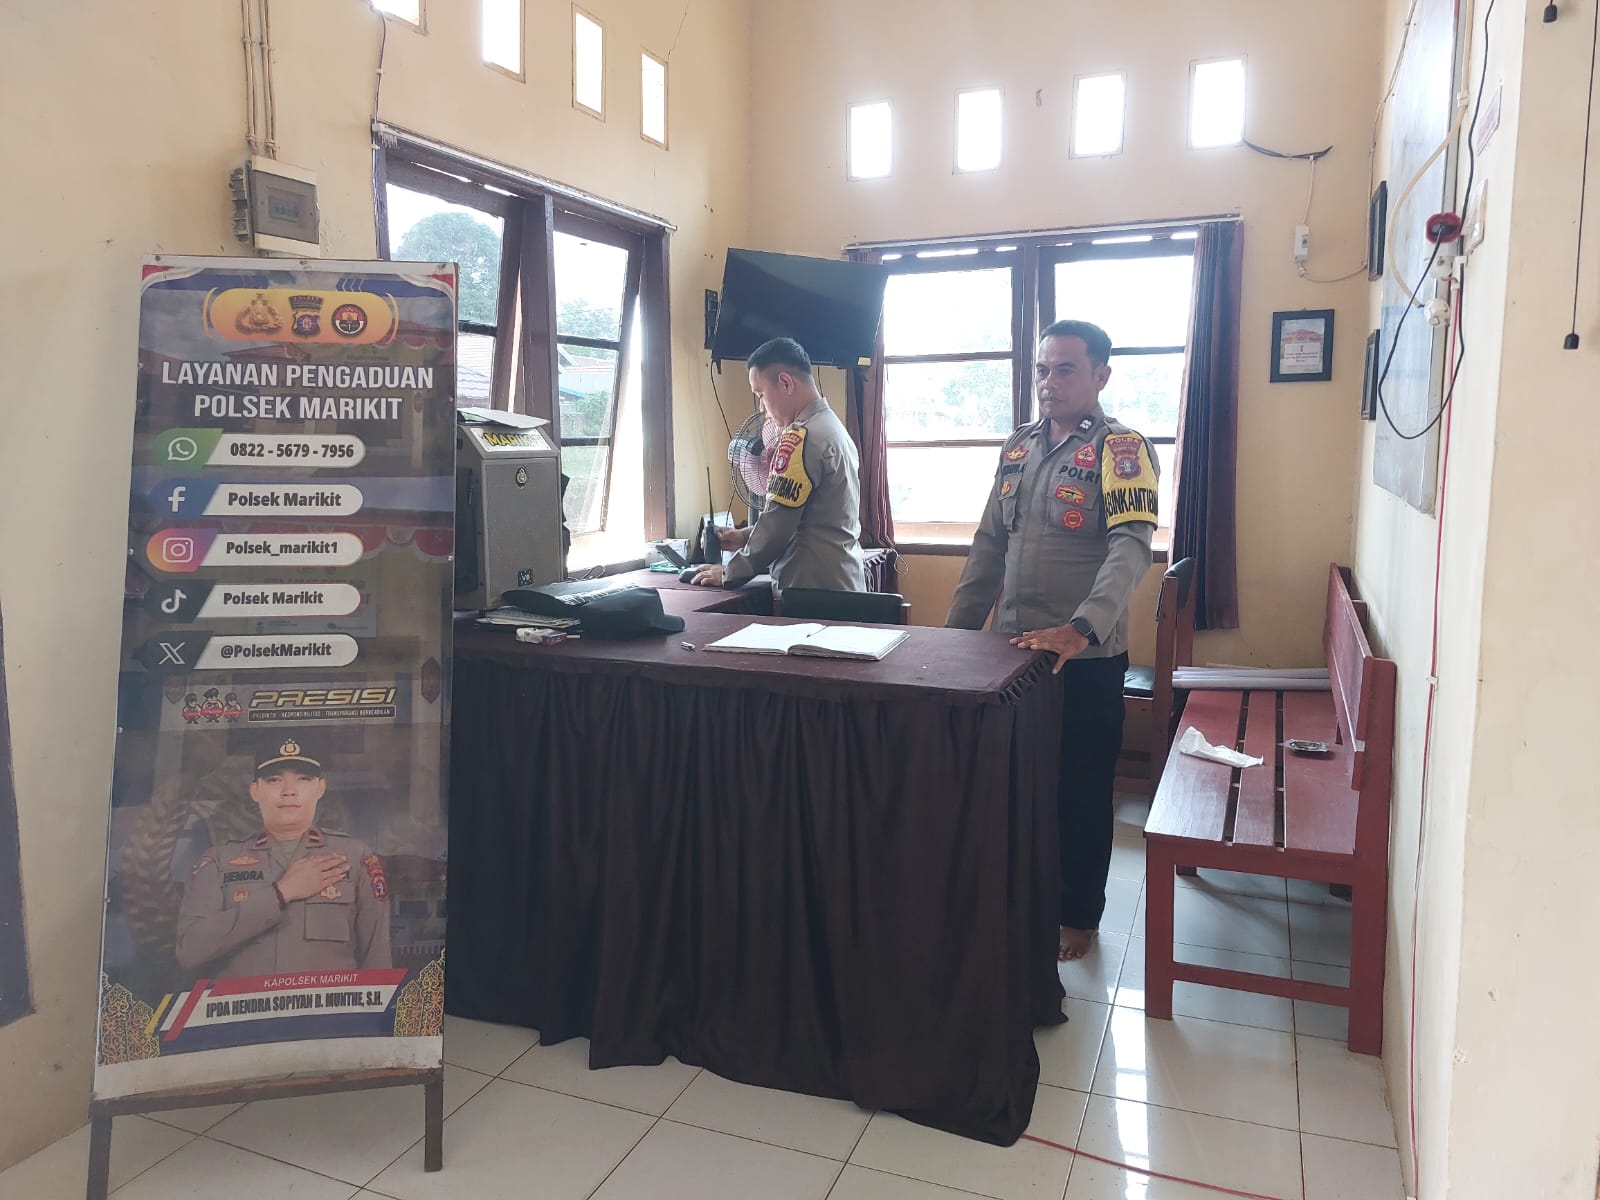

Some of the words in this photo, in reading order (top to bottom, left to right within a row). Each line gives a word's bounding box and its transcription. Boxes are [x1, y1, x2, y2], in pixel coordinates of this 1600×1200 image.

[162, 361, 277, 386] LAYANAN
[286, 365, 433, 389] PENGADUAN
[194, 395, 291, 418] POLSEK
[300, 397, 402, 420] MARIKIT
[483, 432, 541, 446] MARIK
[230, 442, 264, 458] 0822
[276, 443, 310, 458] 5679
[321, 443, 354, 458] 7956
[1058, 465, 1101, 485] POLRI
[228, 492, 280, 506] Polsek
[283, 491, 342, 507] Marikit
[225, 541, 338, 556] Polsek_marikit1
[223, 592, 269, 605] Polsek
[272, 590, 323, 604] Marikit
[220, 643, 332, 658] @PolsekMarikit
[224, 870, 264, 883] HENDRA
[264, 976, 317, 988] KAPOLSEK
[320, 973, 358, 985] MARIKIT
[232, 998, 271, 1014] HENDRA
[273, 994, 313, 1011] SOPIYAN
